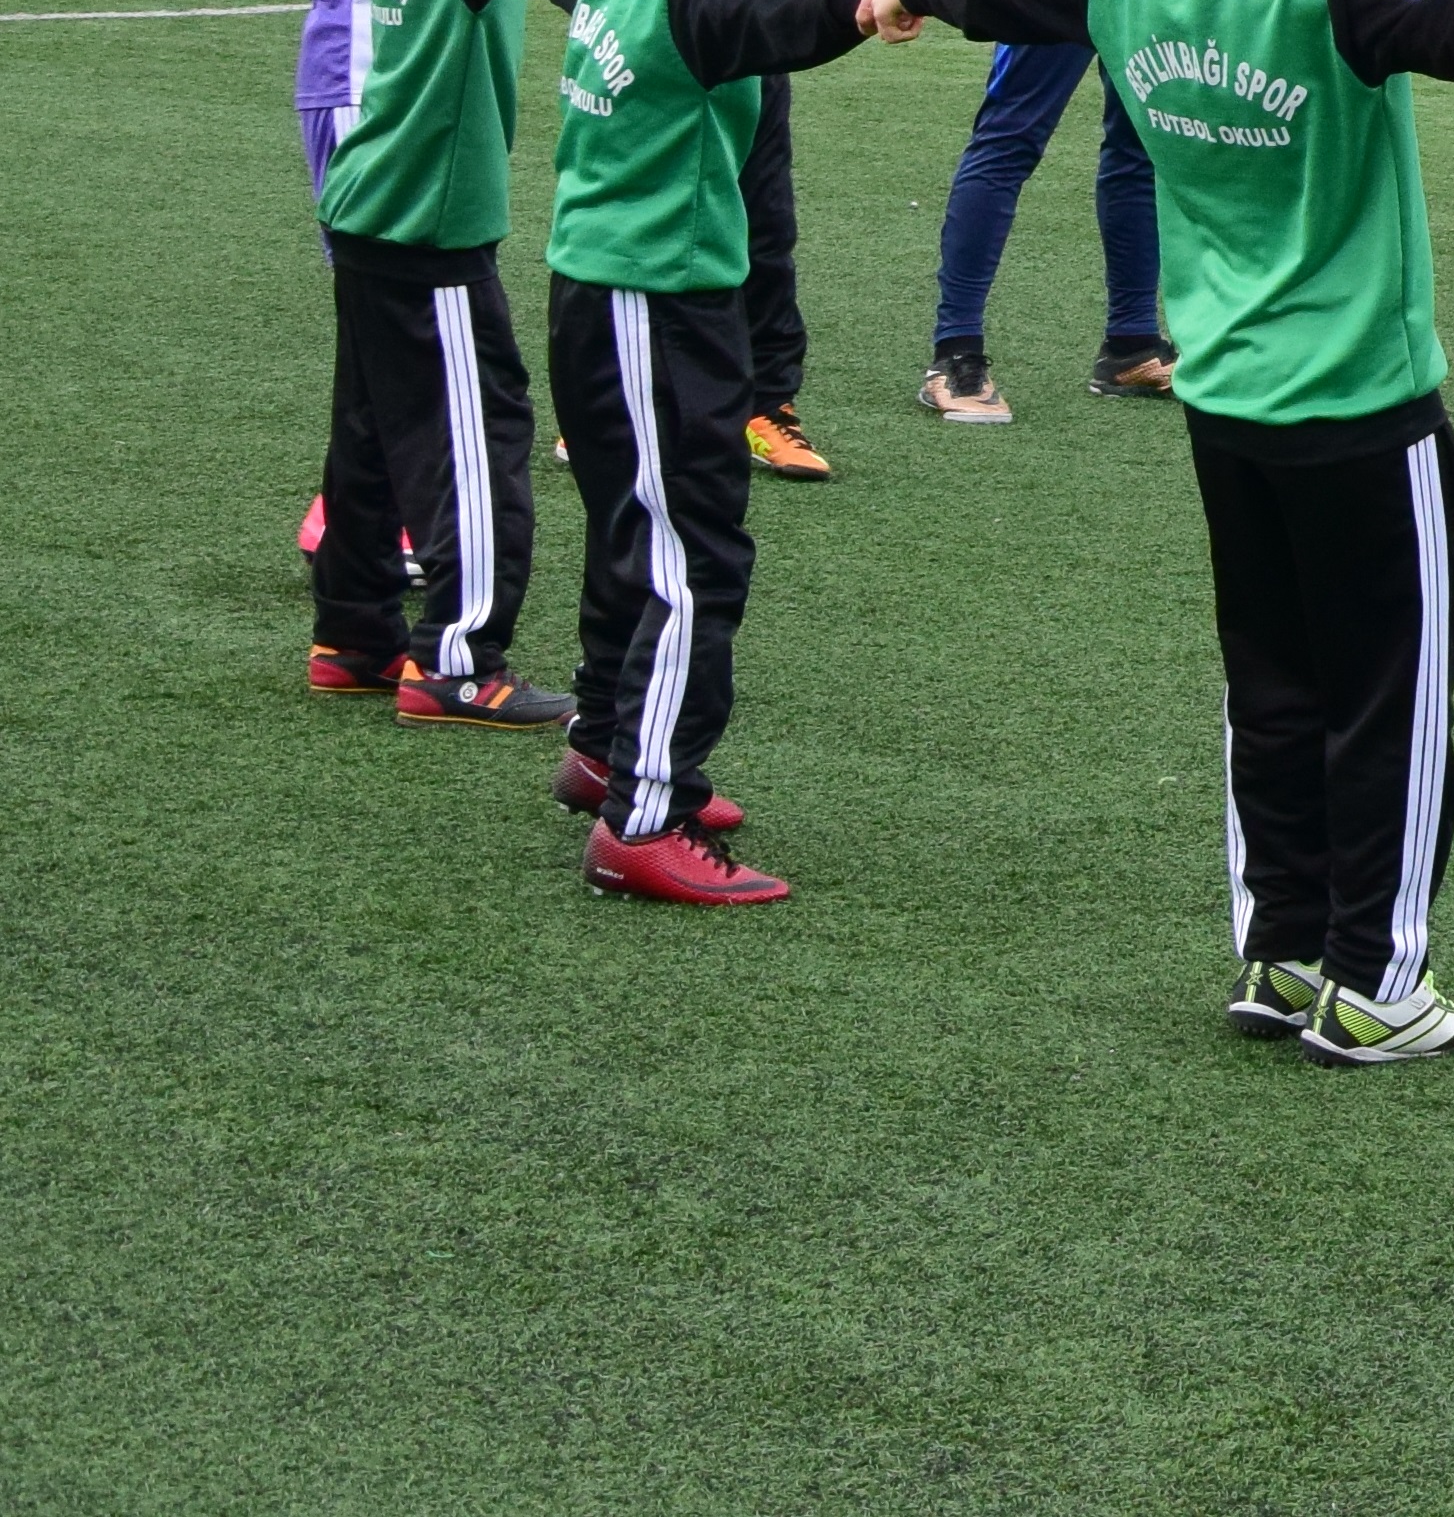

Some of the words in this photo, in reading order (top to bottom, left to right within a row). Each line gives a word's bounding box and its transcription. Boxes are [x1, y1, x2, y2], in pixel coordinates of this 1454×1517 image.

[1126, 34, 1228, 103] BEYLİKBAĞI
[1234, 62, 1308, 122] SPOR
[1147, 108, 1217, 143] FUTBOL
[1219, 125, 1291, 147] OKULU
